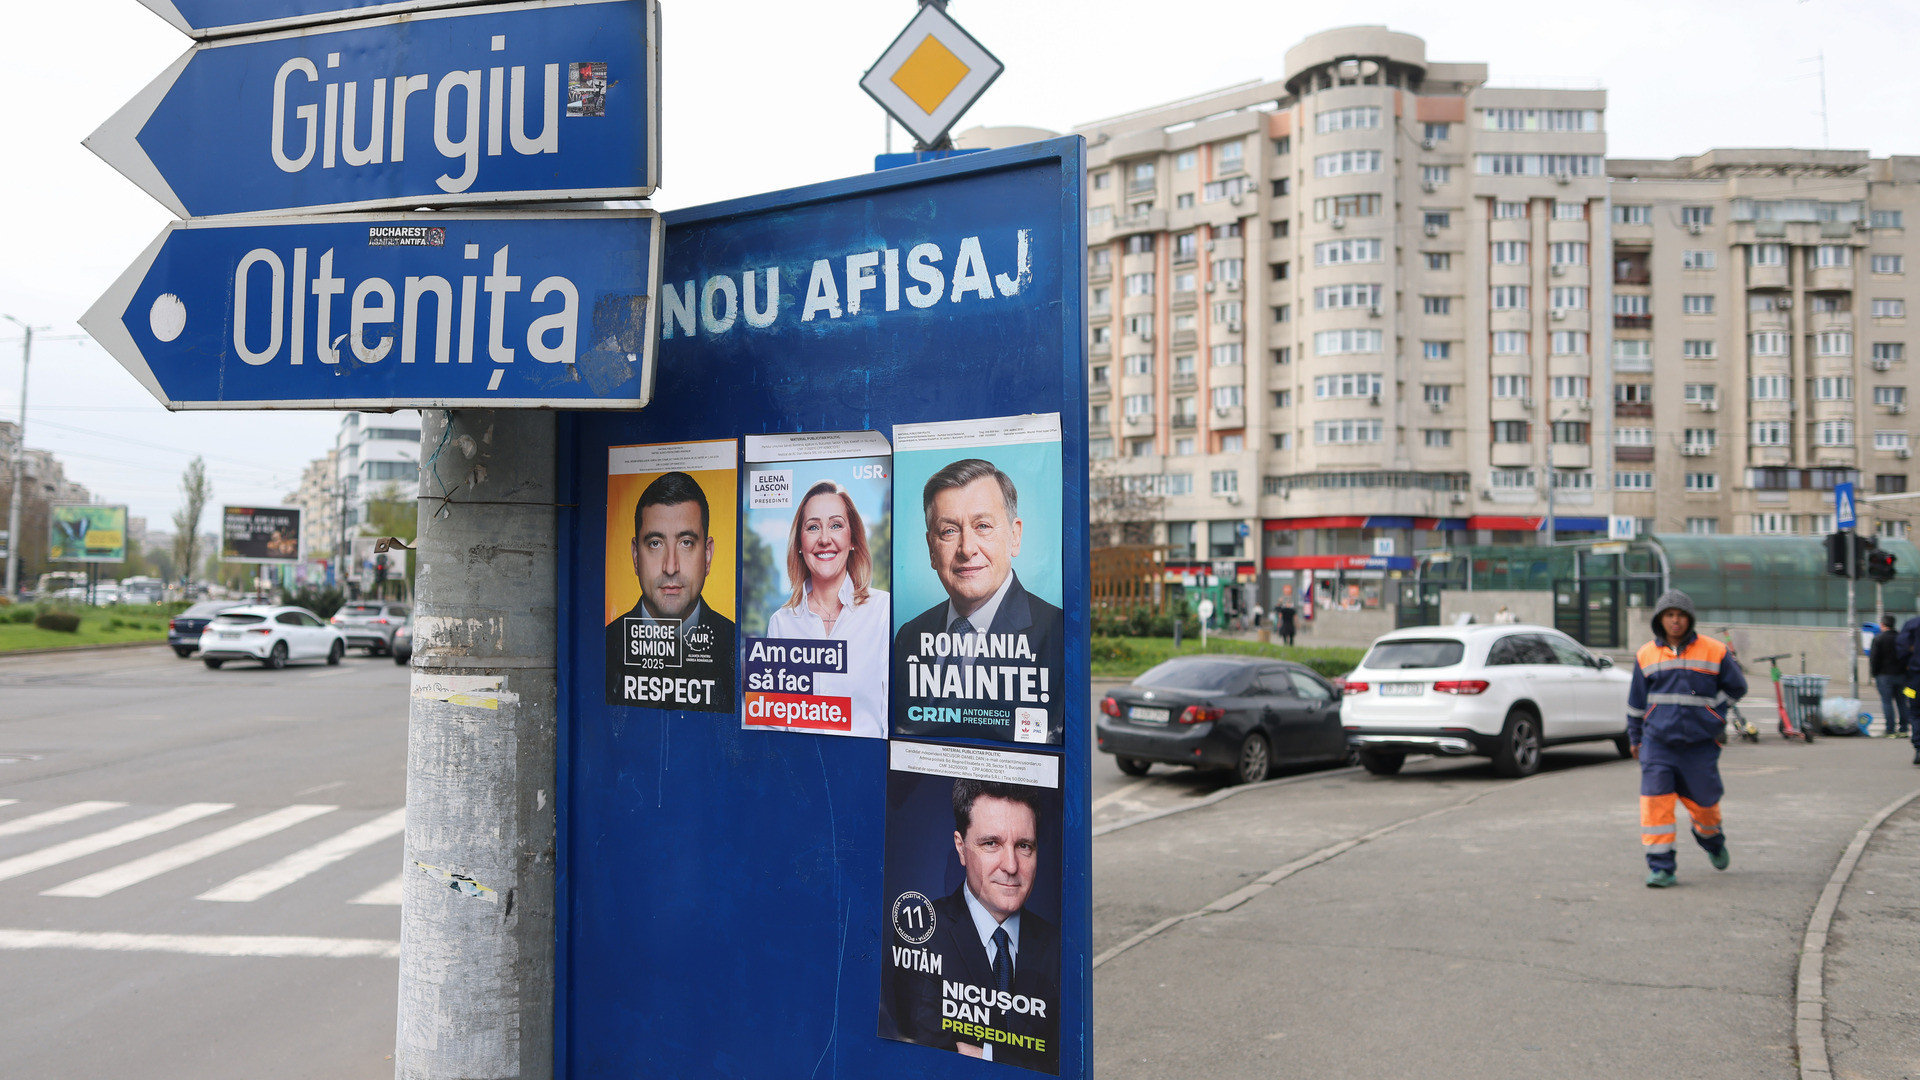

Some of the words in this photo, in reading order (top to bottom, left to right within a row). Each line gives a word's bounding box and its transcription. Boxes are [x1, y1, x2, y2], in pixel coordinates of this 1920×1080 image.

[271, 35, 560, 193] Giurgiu
[369, 227, 428, 237] BUCHAREST
[800, 228, 1033, 323] AFISAJ
[233, 243, 580, 391] Oltenița
[754, 483, 789, 492] LASCONI
[759, 475, 785, 483] ELENA
[1617, 519, 1631, 536] M
[630, 624, 675, 640] GEORGE
[690, 633, 709, 644] AUR
[630, 640, 675, 657] SIMION
[748, 641, 786, 663] Am
[789, 642, 843, 671] curaj
[920, 627, 1037, 663] ROMÂNIA,
[641, 658, 665, 670] 2025
[624, 675, 716, 705] RESPECT
[748, 668, 774, 690] să
[777, 668, 811, 692] fac
[906, 654, 1050, 703] ÎNAINTE!
[748, 695, 848, 724] dreptate.
[907, 705, 962, 723] CRIN
[962, 708, 1011, 718] ANTONESCU
[962, 717, 1010, 726] PREȘEDINTE
[902, 905, 924, 929] 11
[892, 945, 943, 976] VOTĂM
[942, 979, 1047, 1018] NICUȘOR
[942, 998, 990, 1026] DAN
[941, 1017, 1046, 1052] PREȘEDINTE
